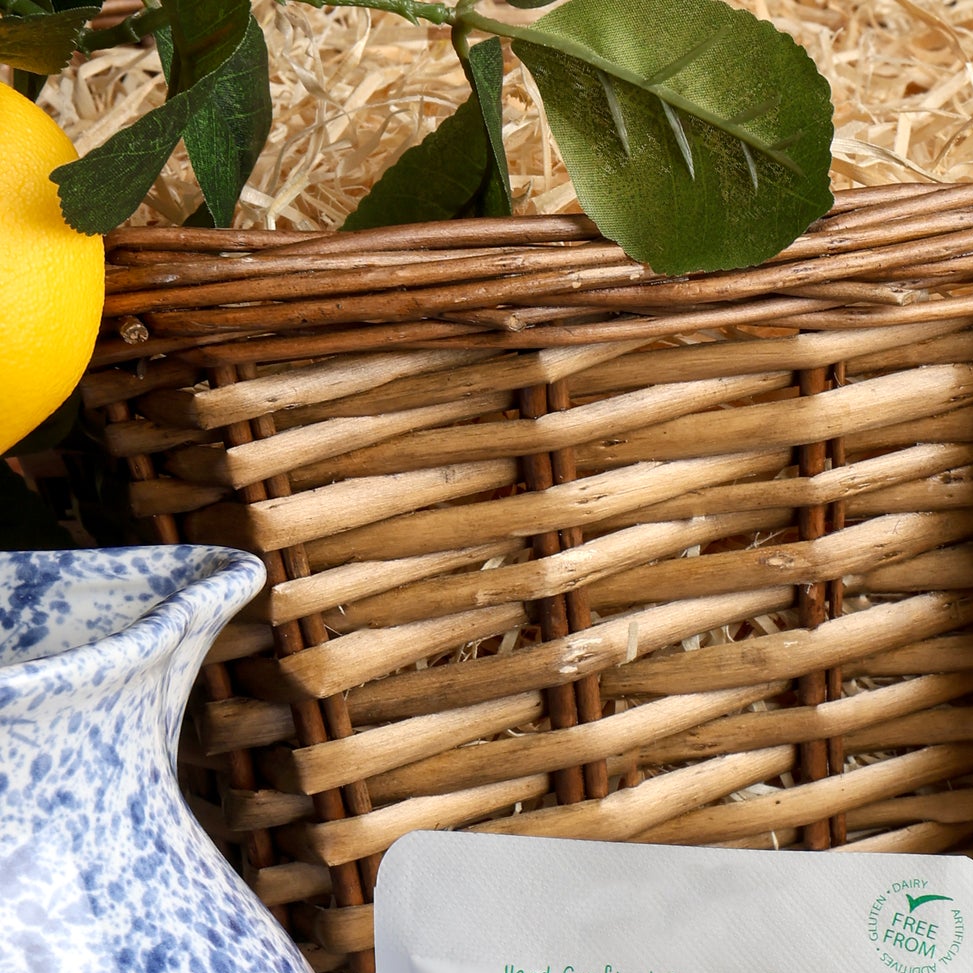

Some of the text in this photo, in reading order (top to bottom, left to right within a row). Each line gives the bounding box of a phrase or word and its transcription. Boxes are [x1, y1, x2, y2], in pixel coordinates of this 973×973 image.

[868, 879, 928, 941] GLUTEN DAIRY
[892, 912, 939, 940] FREE
[883, 929, 936, 959] FROM
[939, 909, 964, 965] ARTIFICIAL
